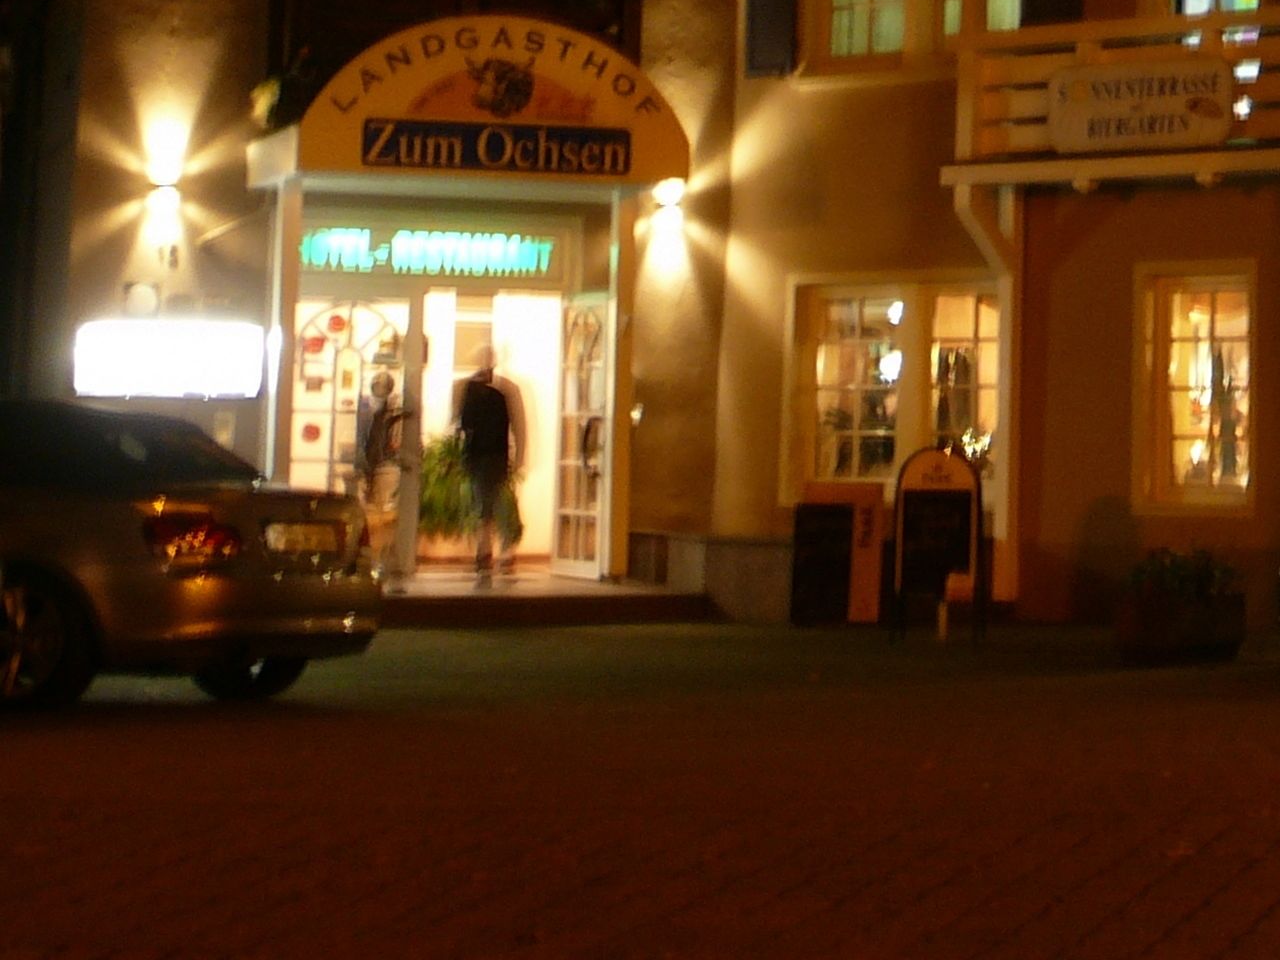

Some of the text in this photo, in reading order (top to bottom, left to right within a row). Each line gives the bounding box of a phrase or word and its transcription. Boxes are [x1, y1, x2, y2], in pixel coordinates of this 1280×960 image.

[330, 26, 662, 115] LANDGASTHOF
[364, 121, 627, 172] Zum Ochsen
